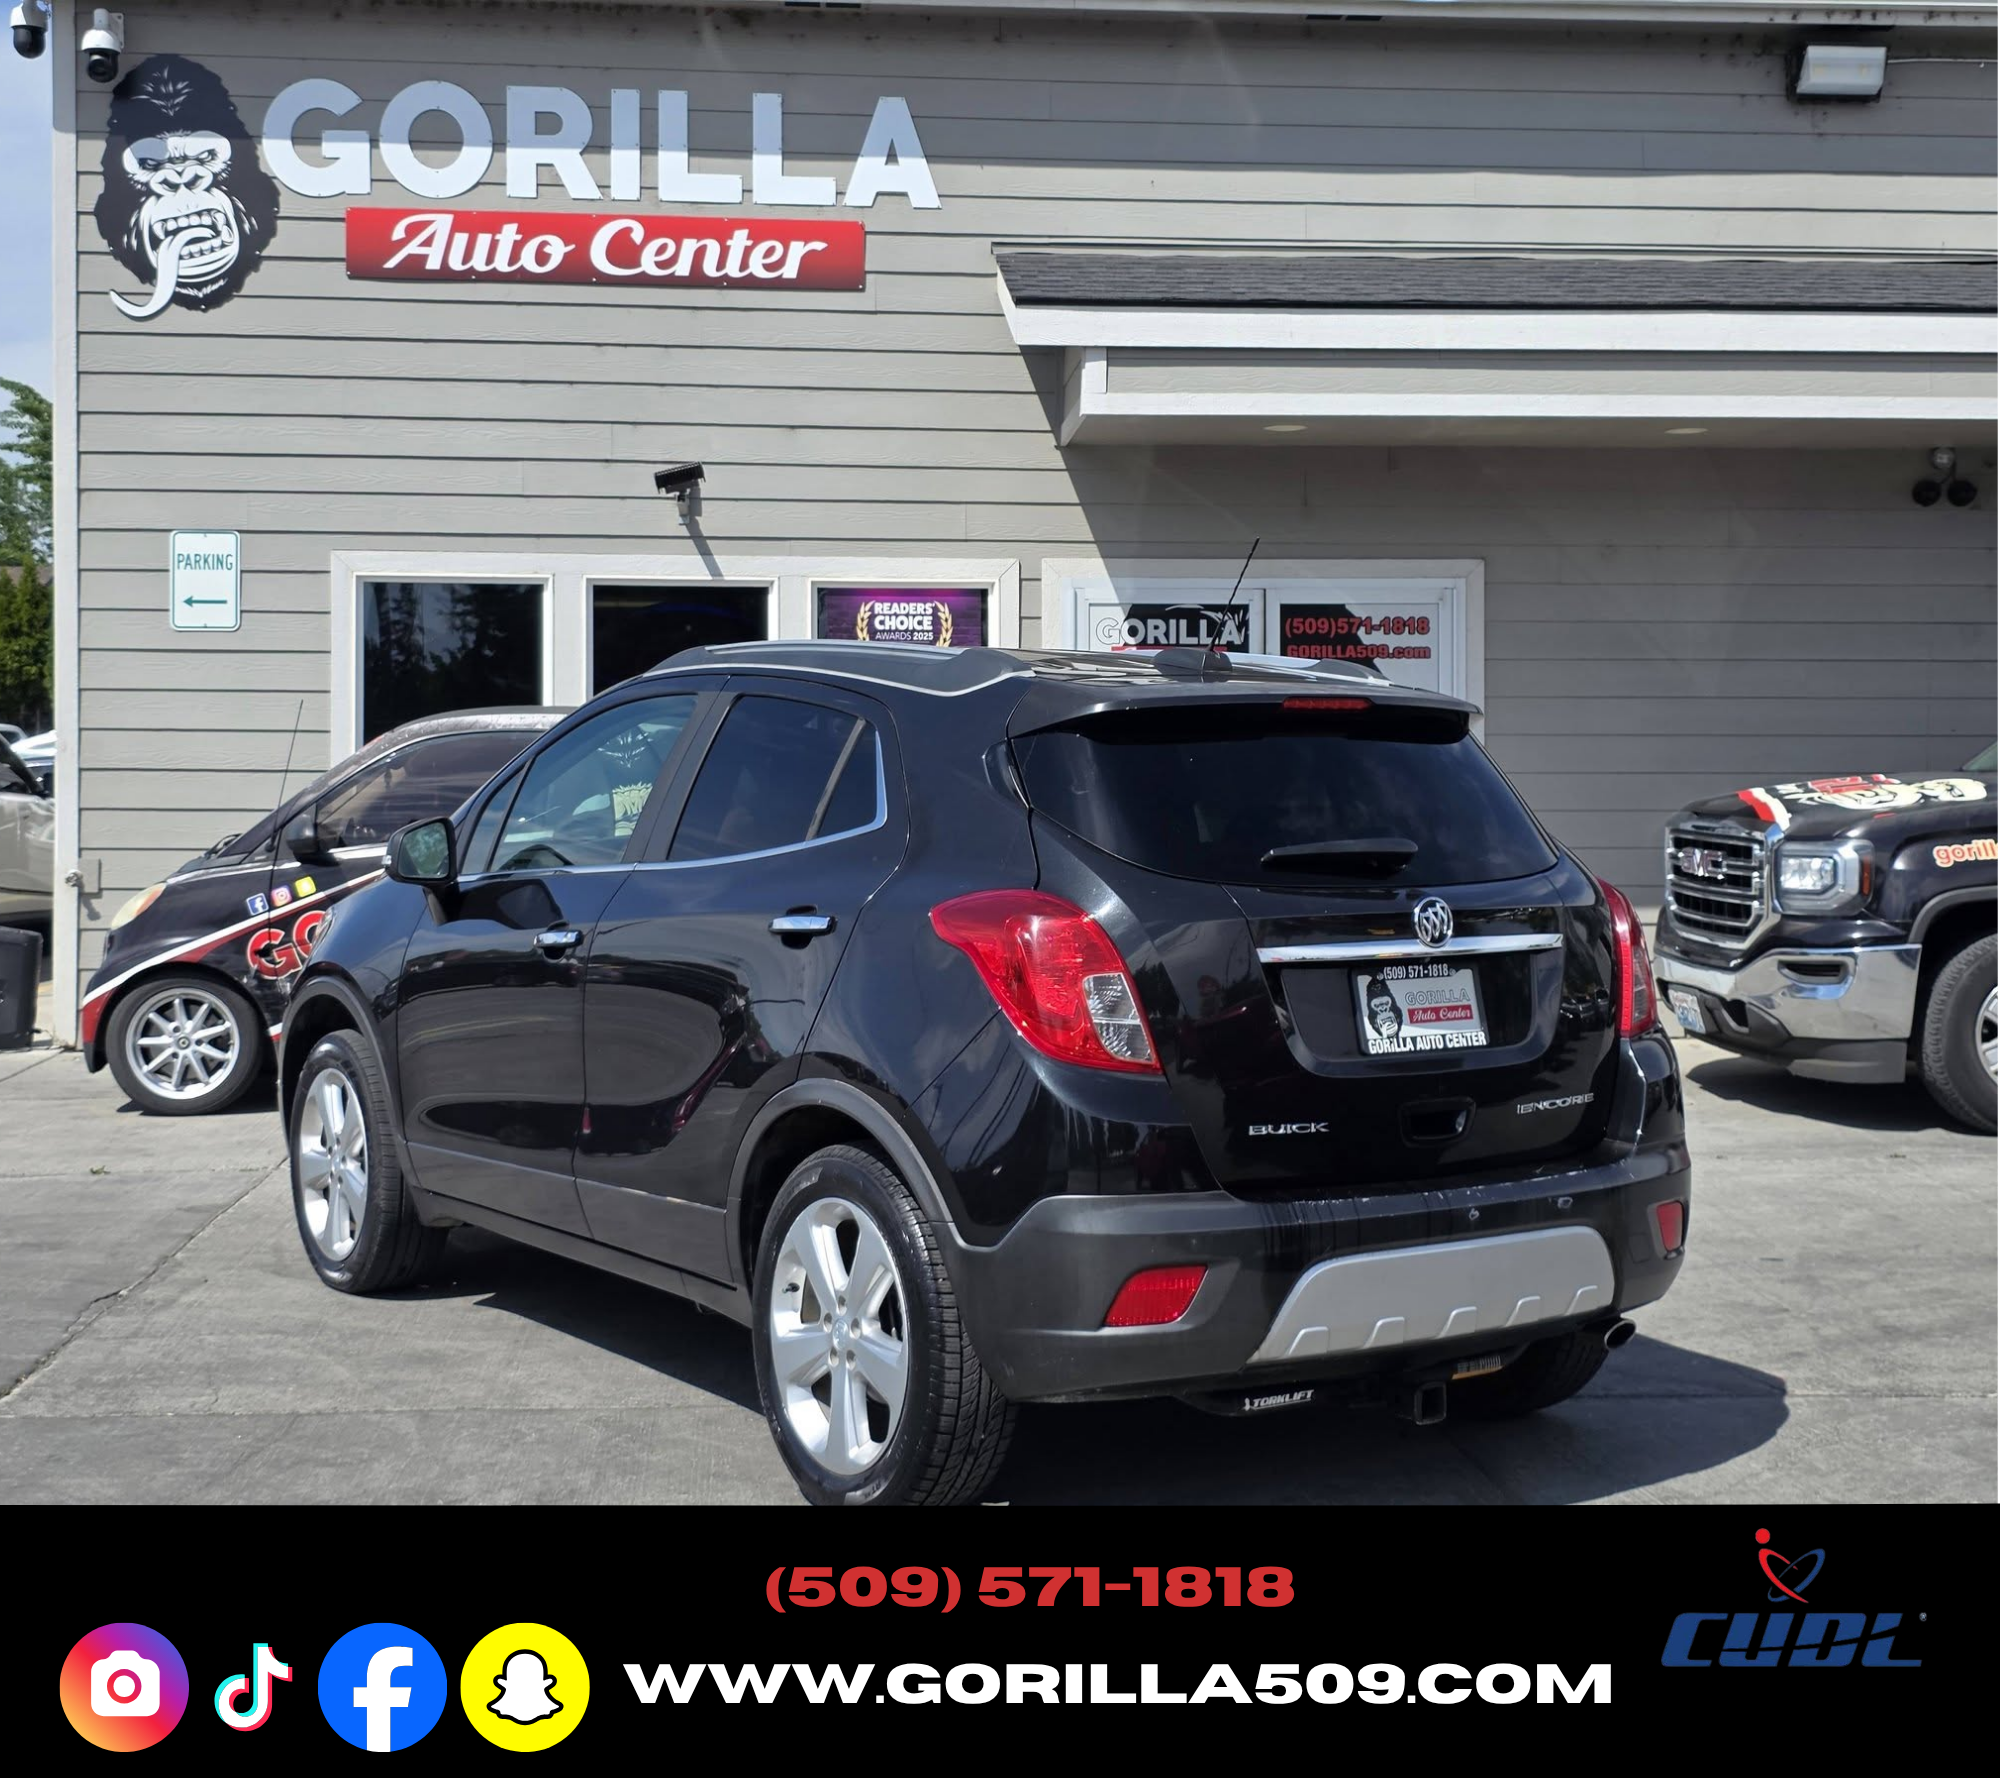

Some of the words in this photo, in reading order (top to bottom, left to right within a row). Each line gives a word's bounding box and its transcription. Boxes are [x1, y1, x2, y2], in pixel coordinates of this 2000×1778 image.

[263, 78, 942, 209] GORILLA
[383, 213, 576, 273] Auto
[591, 218, 828, 281] Center
[177, 553, 233, 571] PARKING
[874, 602, 936, 615] READERS'
[874, 615, 933, 631] CHOICE
[1096, 617, 1243, 646] GORILLA
[1285, 616, 1430, 638] (509)571-1818
[875, 631, 911, 641] AWARDS
[913, 631, 934, 641] 2025
[1287, 644, 1431, 659] GORILLA509.com
[1933, 839, 1998, 867] gorill
[1383, 966, 1406, 980] (509)
[1408, 963, 1449, 978] 571-1818
[1404, 988, 1471, 1006] GORILLA
[1412, 1008, 1436, 1022] Auto
[1439, 1006, 1472, 1020] Center
[1416, 1034, 1444, 1050] AUTO
[1446, 1031, 1487, 1047] CENTER
[1249, 1122, 1330, 1136] BUICK
[1253, 1389, 1315, 1408] TORKLIFT
